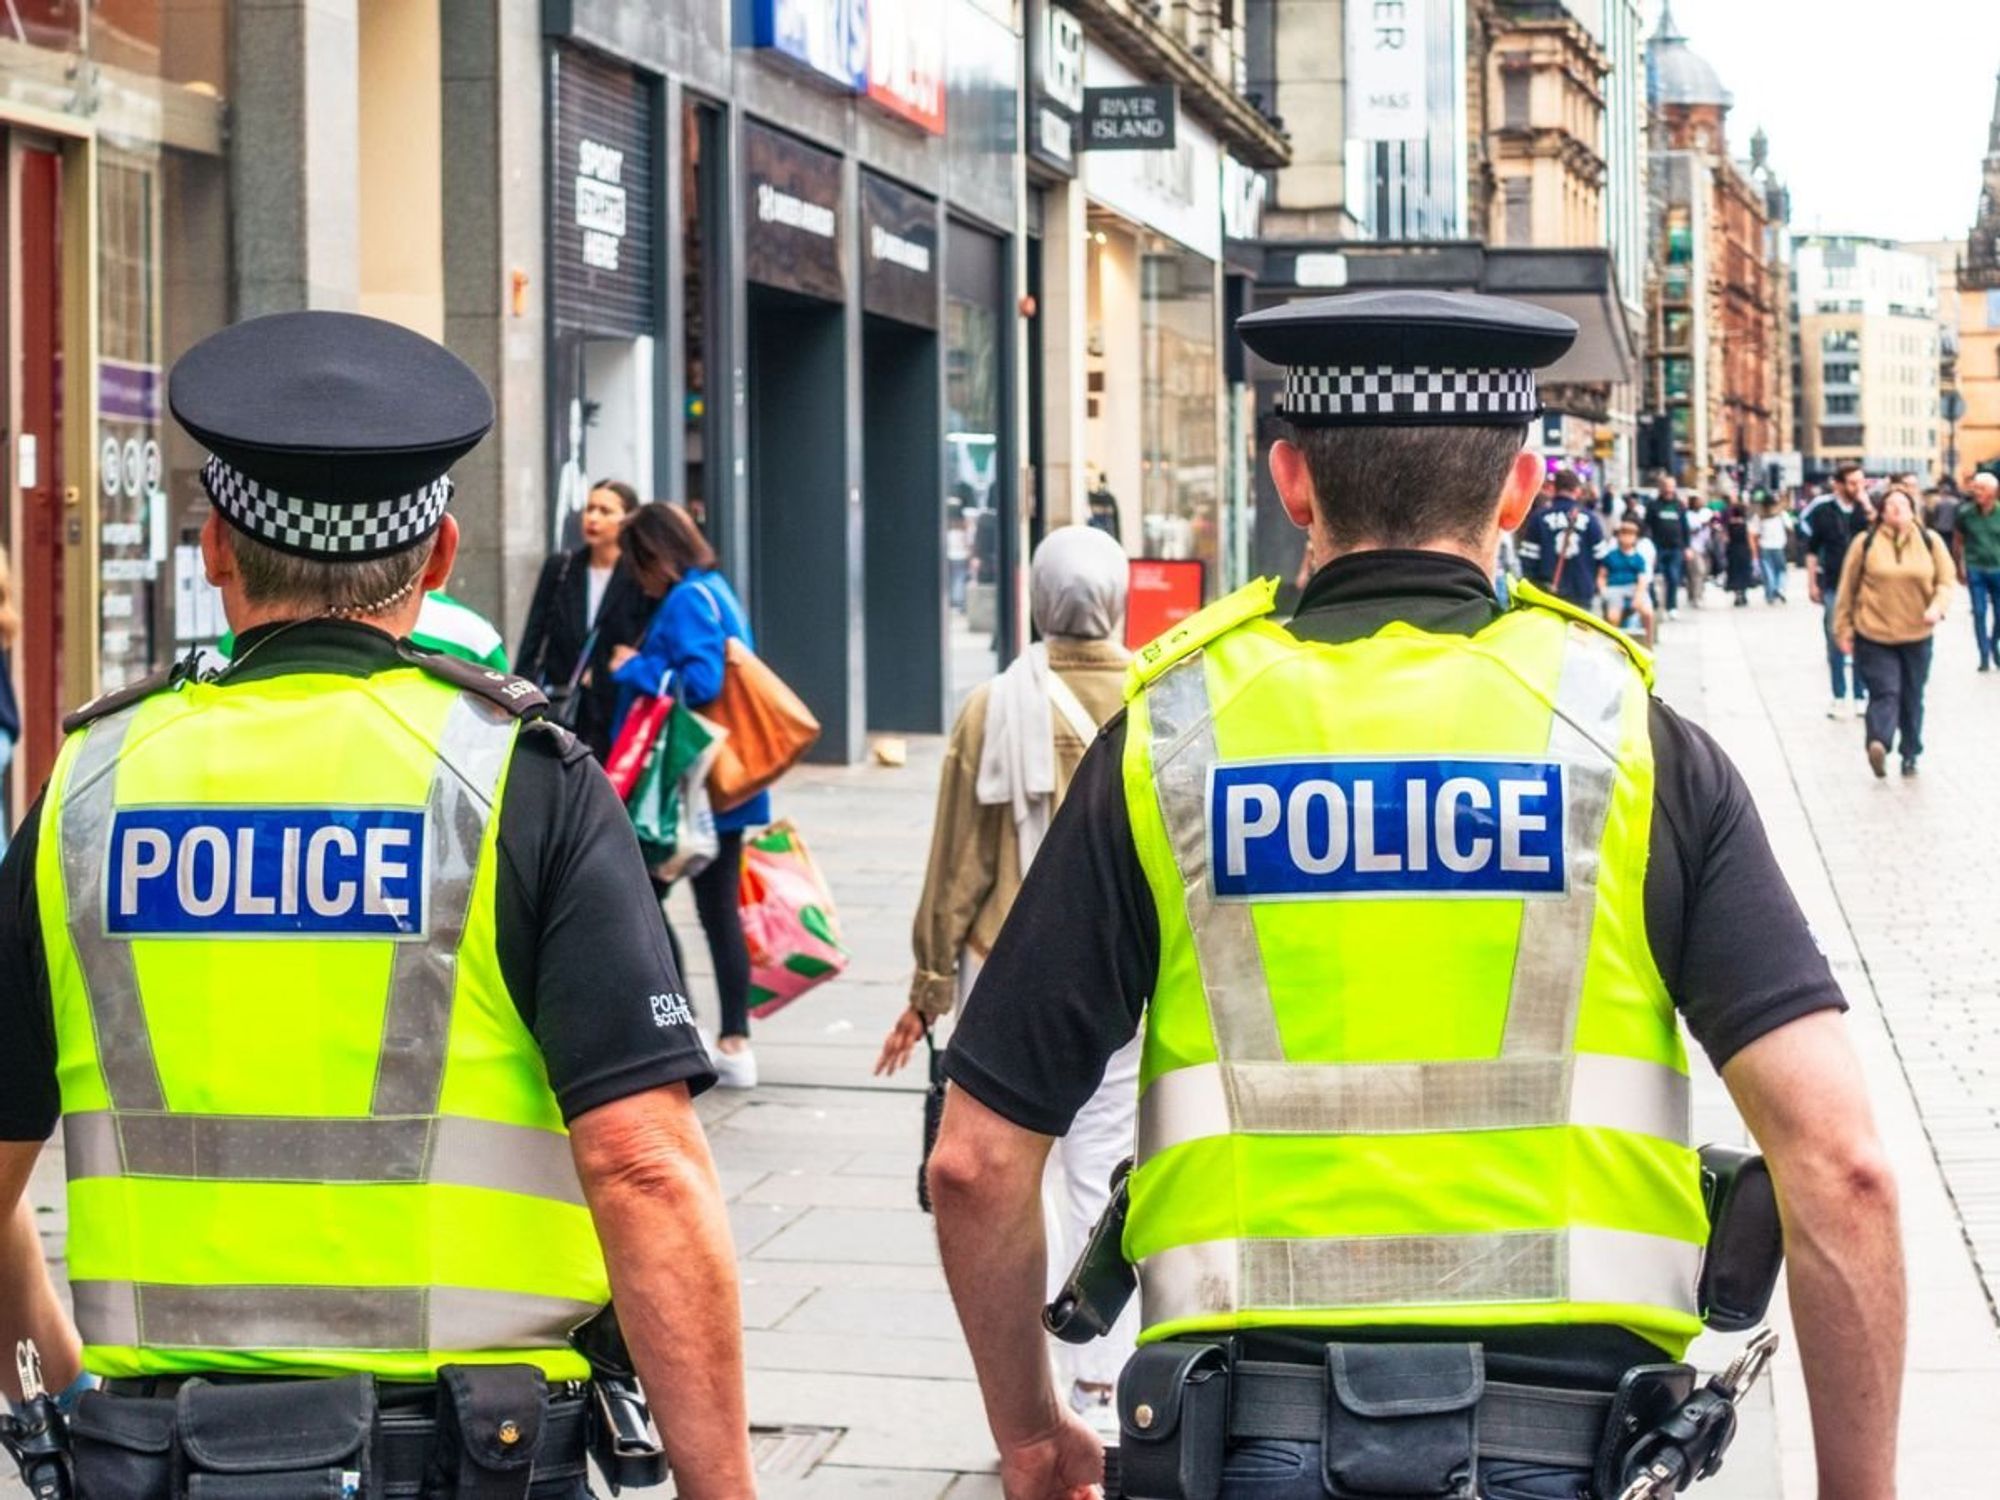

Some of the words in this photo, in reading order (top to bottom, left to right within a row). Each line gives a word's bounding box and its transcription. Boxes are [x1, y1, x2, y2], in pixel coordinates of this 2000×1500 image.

[1098, 97, 1157, 115] RIVER
[1369, 95, 1410, 108] M&S
[1091, 118, 1165, 138] ISLAND
[1226, 777, 1550, 877] POLICE
[120, 825, 411, 918] POLICE
